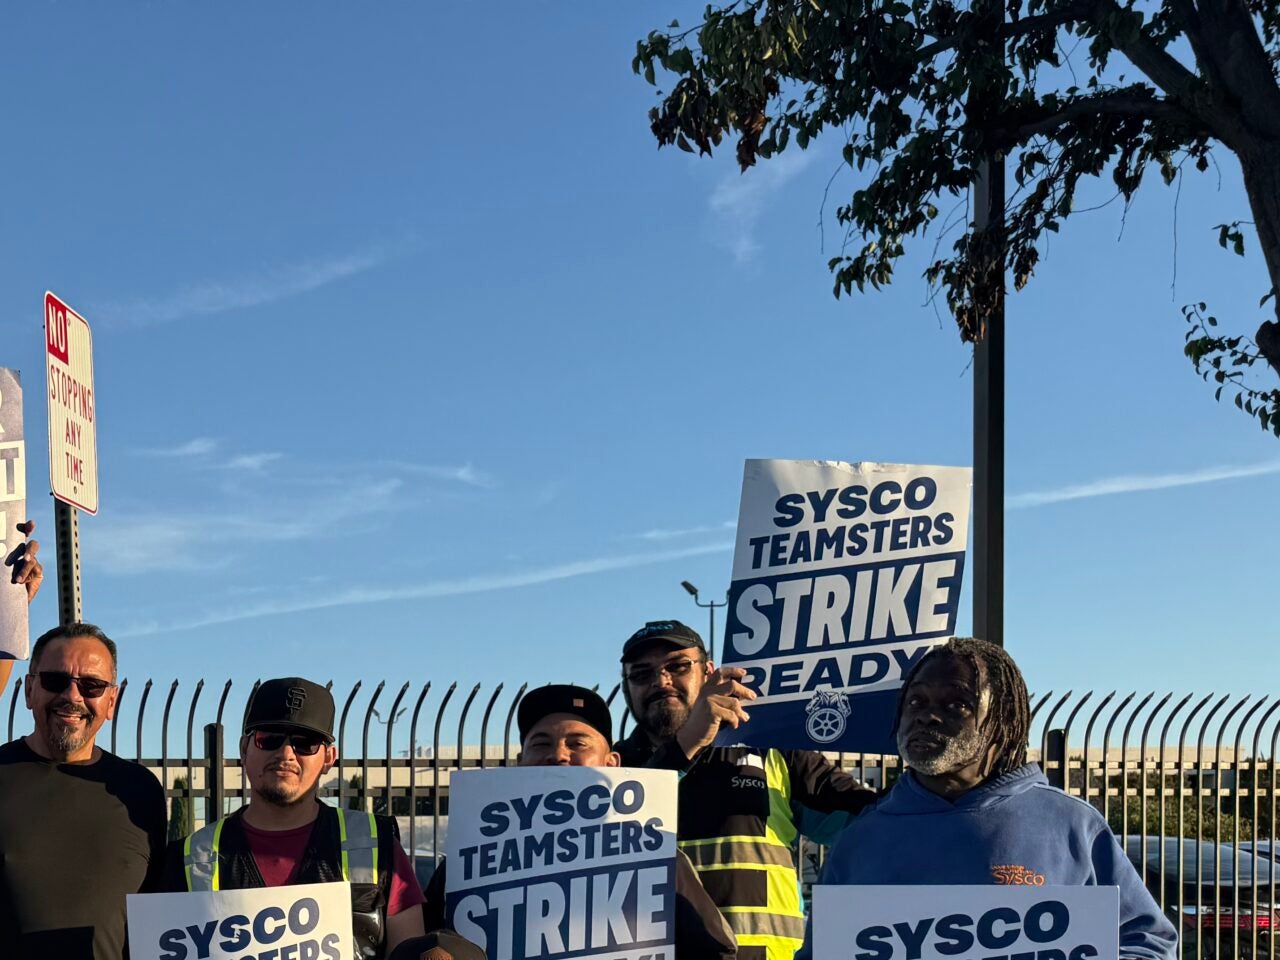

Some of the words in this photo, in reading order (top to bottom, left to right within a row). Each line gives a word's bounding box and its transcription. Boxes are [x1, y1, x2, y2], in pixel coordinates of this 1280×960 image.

[48, 302, 66, 354] NO
[50, 364, 93, 423] STOPPING
[65, 417, 82, 450] ANY
[65, 452, 84, 486] TIME
[773, 476, 937, 528] SYSCO
[749, 512, 955, 570] TEAMSTERS
[732, 559, 957, 656] STRIKE
[739, 645, 942, 697] READY
[479, 780, 645, 837] SYSCO
[459, 817, 664, 881] TEAMSTERS
